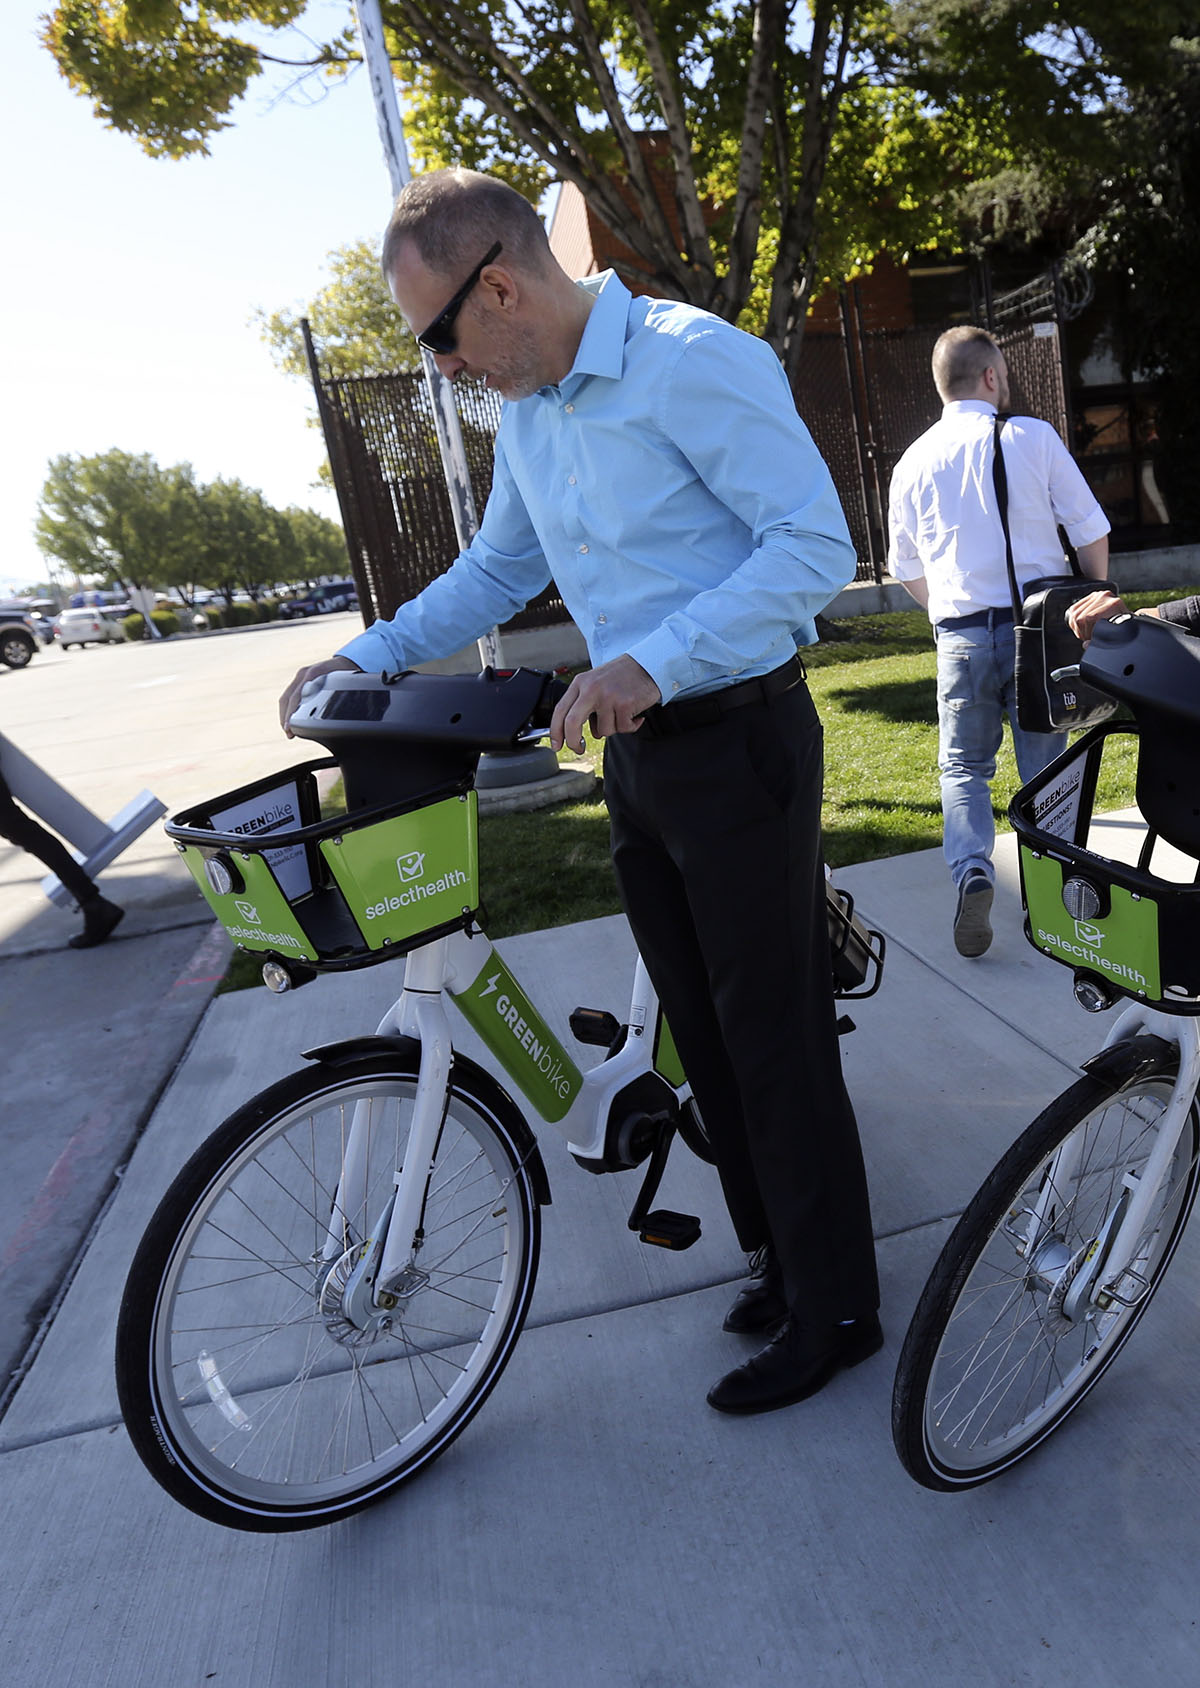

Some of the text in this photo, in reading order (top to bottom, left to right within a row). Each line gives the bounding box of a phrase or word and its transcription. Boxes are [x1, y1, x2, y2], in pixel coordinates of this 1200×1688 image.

[365, 869, 466, 920] selecthealth
[226, 925, 301, 948] selecthealth
[1038, 928, 1146, 986] selecthealth
[496, 995, 570, 1099] GREENbike
